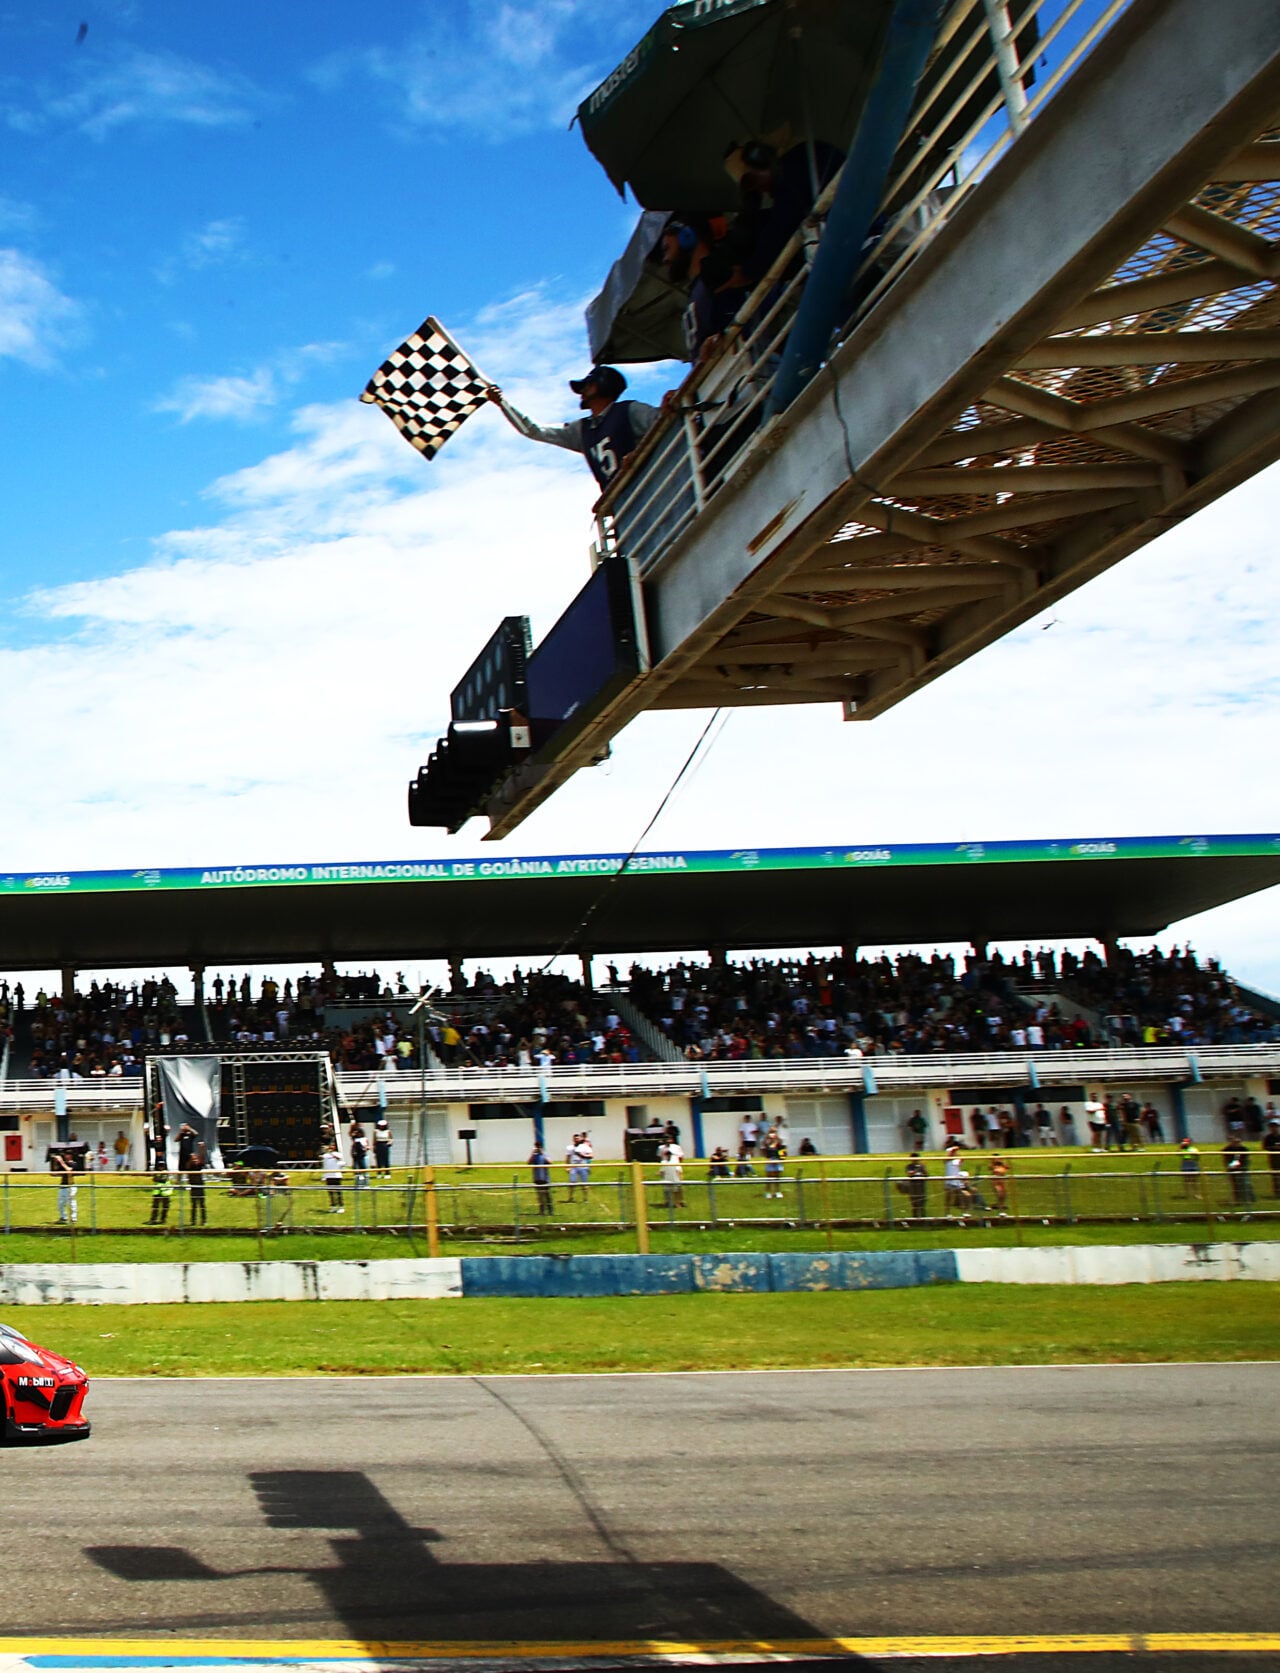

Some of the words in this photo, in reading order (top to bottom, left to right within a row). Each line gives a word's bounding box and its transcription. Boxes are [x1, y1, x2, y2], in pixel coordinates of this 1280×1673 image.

[200, 867, 308, 884] AUTÓDROMO
[312, 864, 449, 879] INTERNACIONAL
[452, 863, 475, 876] DE
[479, 859, 554, 875] GOIÂNIA
[557, 858, 624, 873] AYRTON
[628, 856, 688, 870] SENNA
